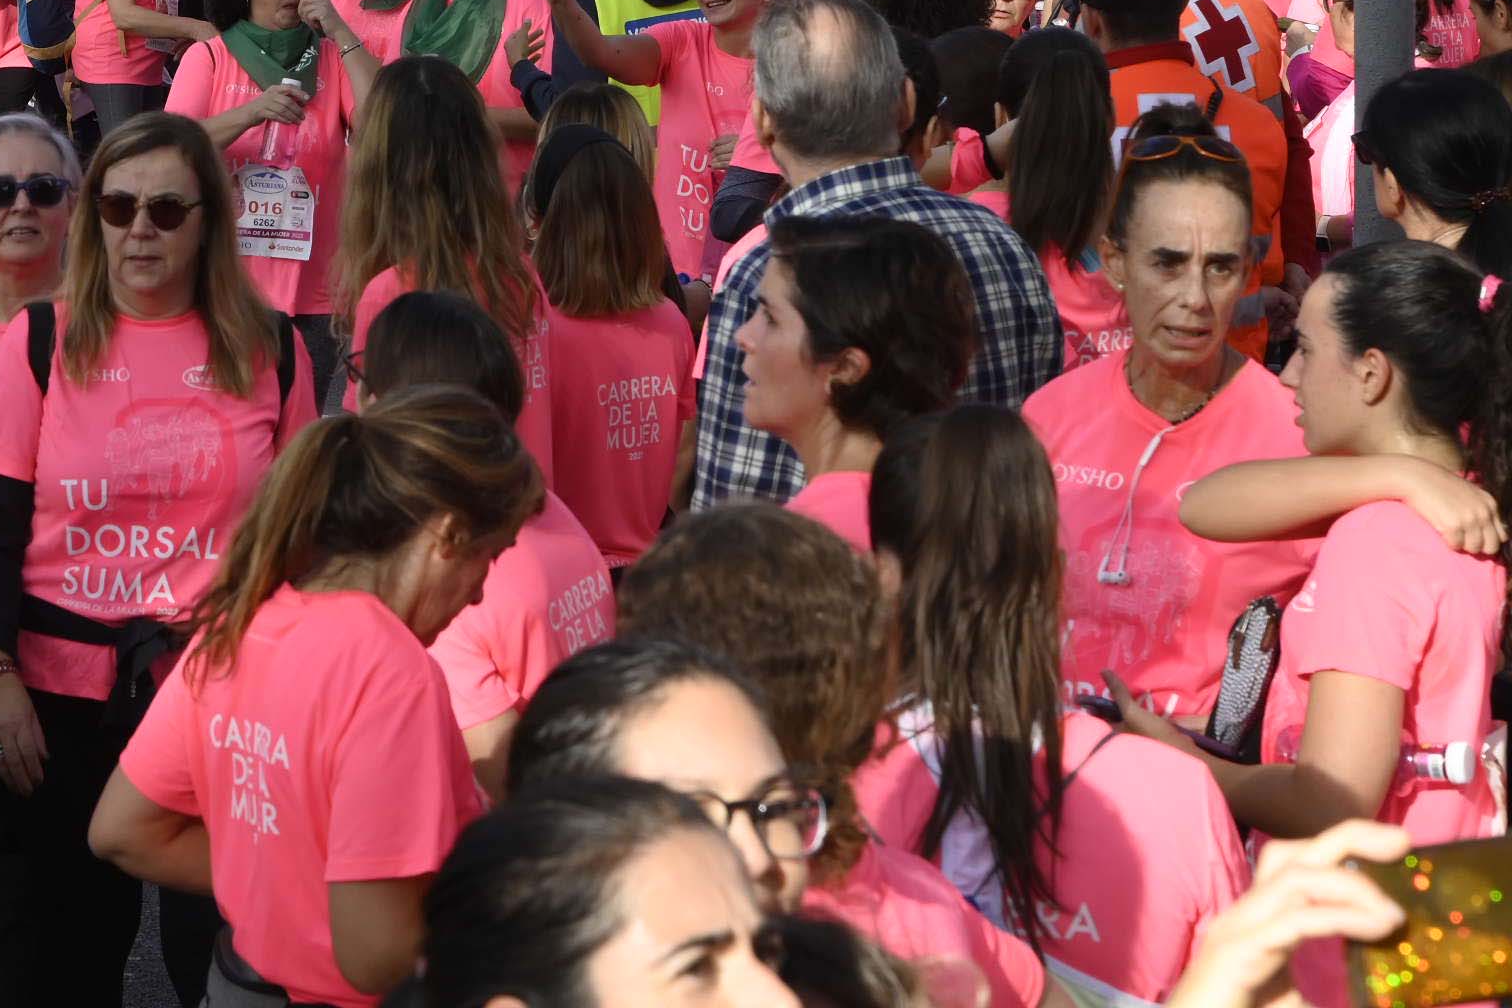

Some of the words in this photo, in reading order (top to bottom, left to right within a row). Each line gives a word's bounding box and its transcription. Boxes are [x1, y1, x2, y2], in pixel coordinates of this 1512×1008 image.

[680, 143, 708, 172] TU
[248, 178, 285, 191] ASTURIANA
[677, 175, 710, 205] DO
[248, 200, 283, 215] 016
[680, 205, 704, 232] SU
[253, 217, 276, 228] 6262
[597, 373, 677, 407] CARRERA
[608, 403, 632, 427] DE
[640, 400, 658, 423] LA
[607, 422, 660, 450] MUJER
[59, 479, 108, 513] TU
[66, 524, 219, 561] DORSAL
[62, 566, 175, 604] SUMA
[548, 568, 610, 631] CARRERA
[565, 618, 587, 655] DE
[585, 607, 606, 640] LA
